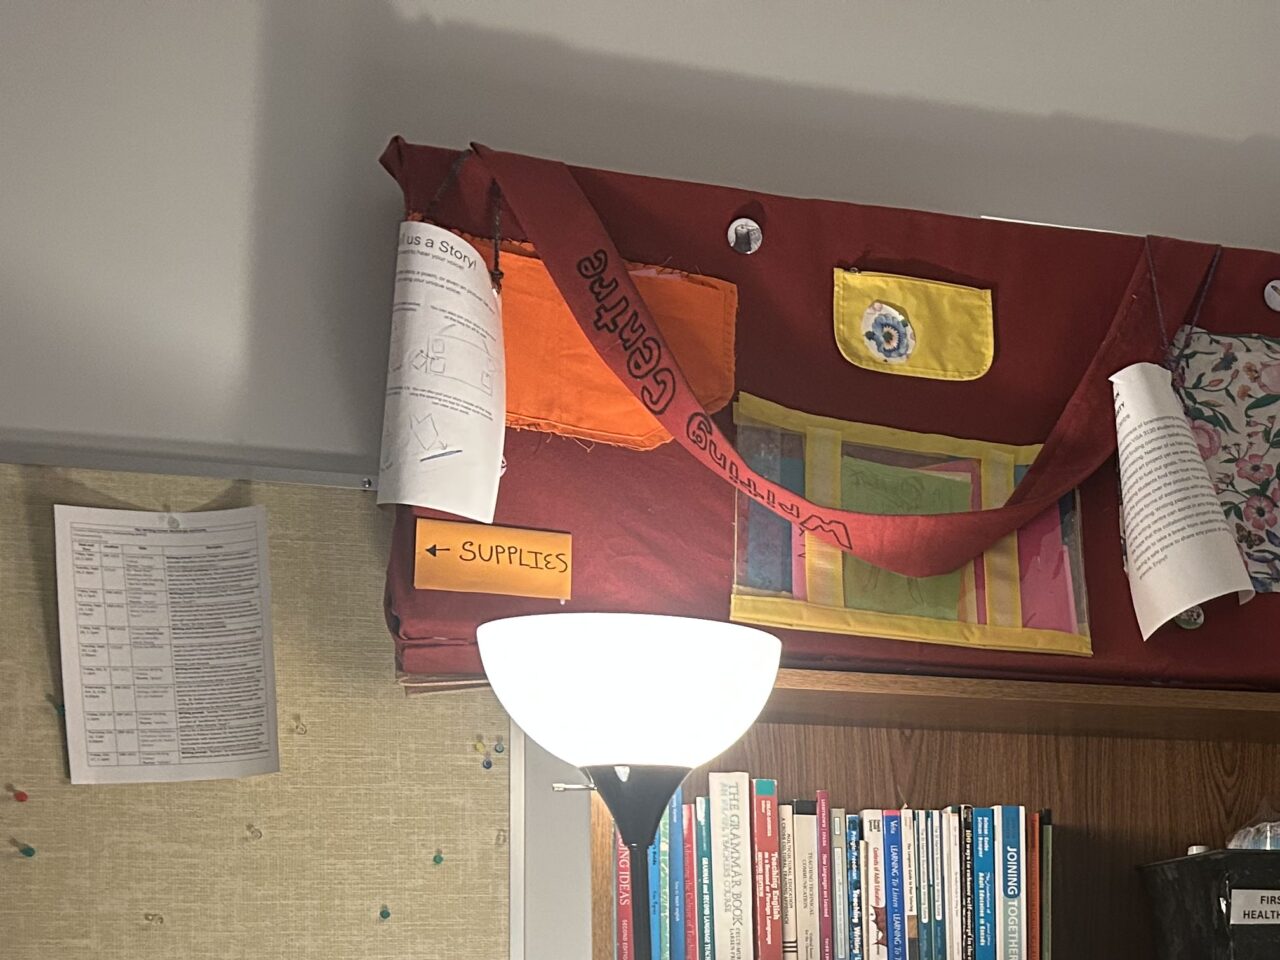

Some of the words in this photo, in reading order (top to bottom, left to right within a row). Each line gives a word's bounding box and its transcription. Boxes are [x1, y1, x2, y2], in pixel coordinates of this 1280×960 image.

[406, 234, 421, 246] us
[425, 238, 434, 248] a
[577, 249, 676, 416] Centre
[686, 411, 852, 550] Writing
[459, 540, 568, 574] SUPPLIES
[728, 782, 740, 811] THE
[729, 814, 743, 889] GRAMMAR
[890, 844, 899, 876] LEARNING
[701, 857, 710, 884] GRAMMAR
[770, 851, 779, 889] Teaching
[892, 878, 899, 887] To
[1007, 845, 1019, 895] JOINING
[619, 871, 631, 906] IDEAS
[702, 894, 710, 915] SECOND
[731, 891, 744, 926] BOOK
[771, 890, 780, 920] English
[852, 889, 861, 923] Teaching
[853, 926, 861, 954] Writing
[893, 913, 901, 945] LEARNING
[895, 946, 900, 955] To
